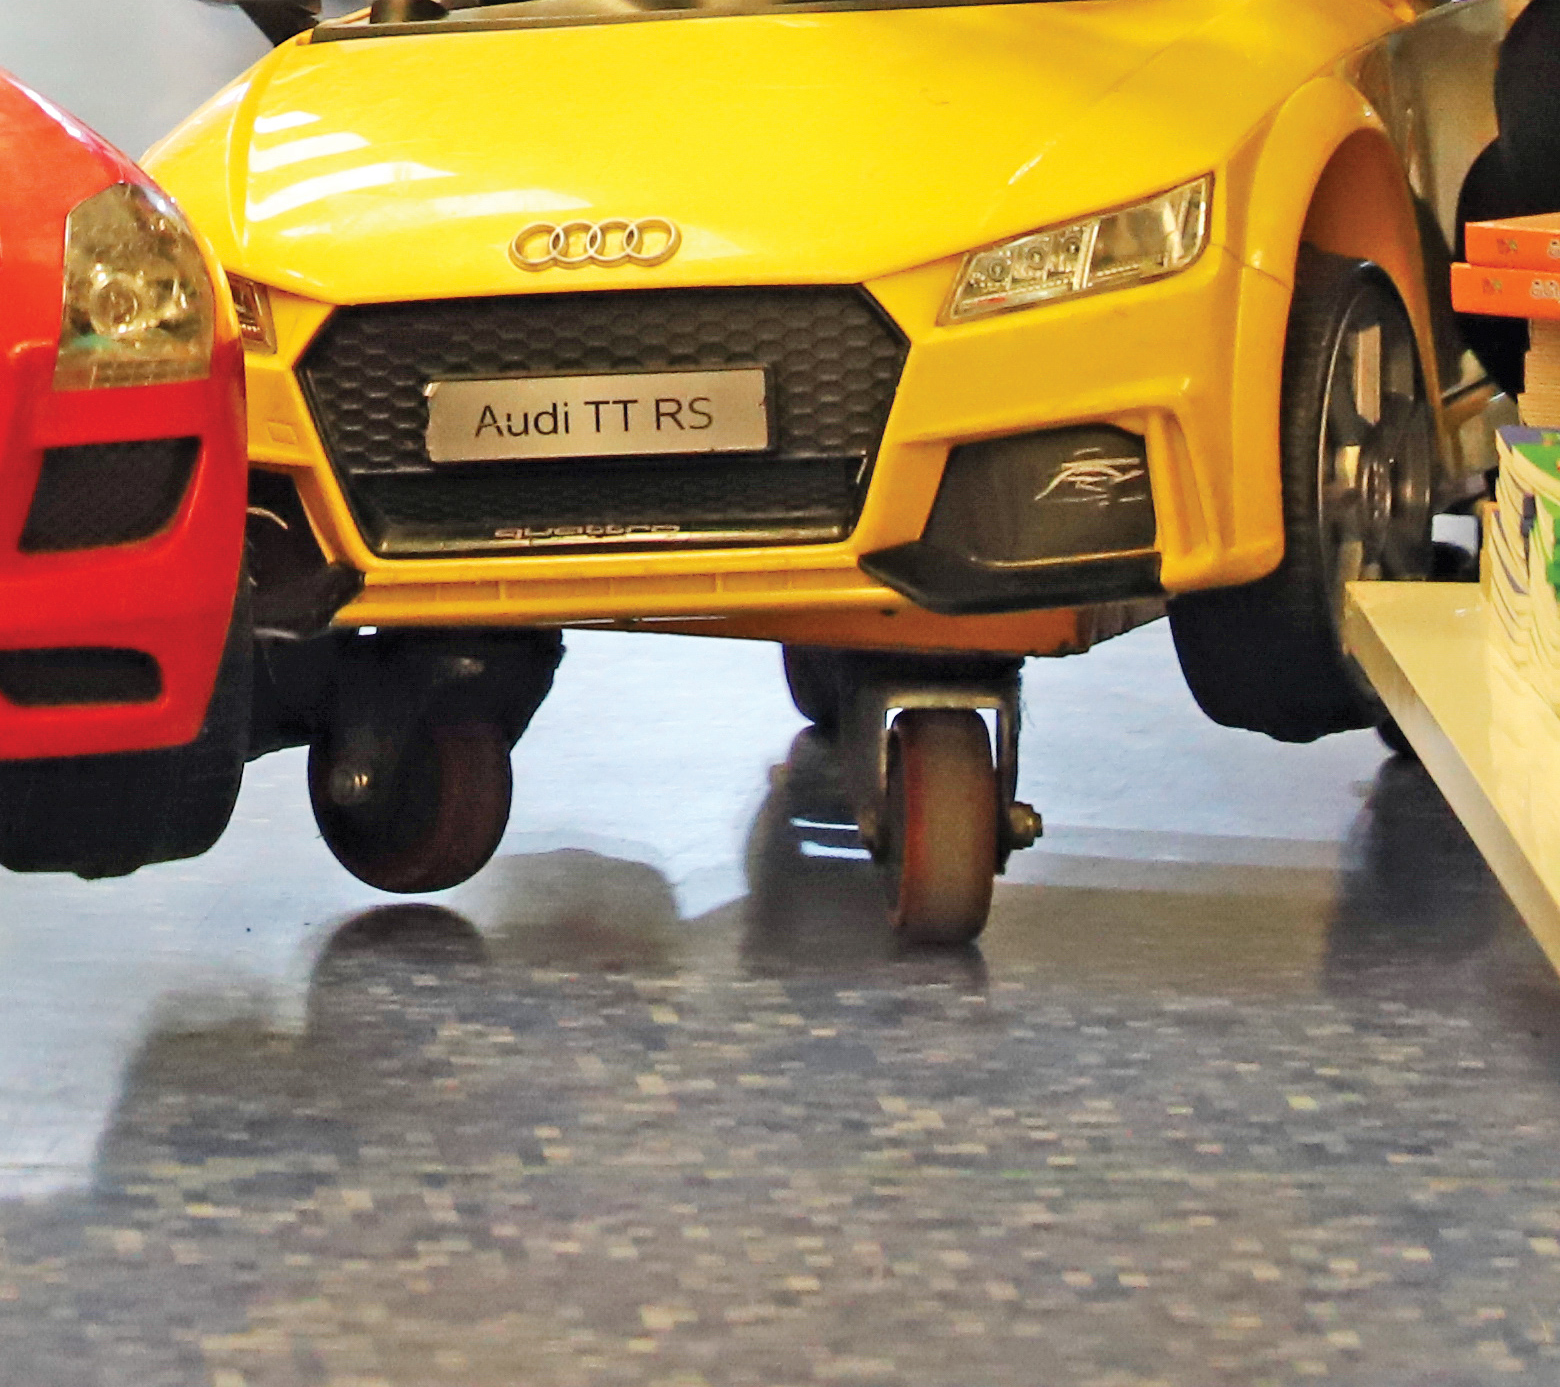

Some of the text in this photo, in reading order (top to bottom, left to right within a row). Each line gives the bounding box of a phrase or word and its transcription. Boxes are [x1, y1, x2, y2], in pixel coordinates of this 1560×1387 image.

[474, 396, 714, 438] Audi TT RS
